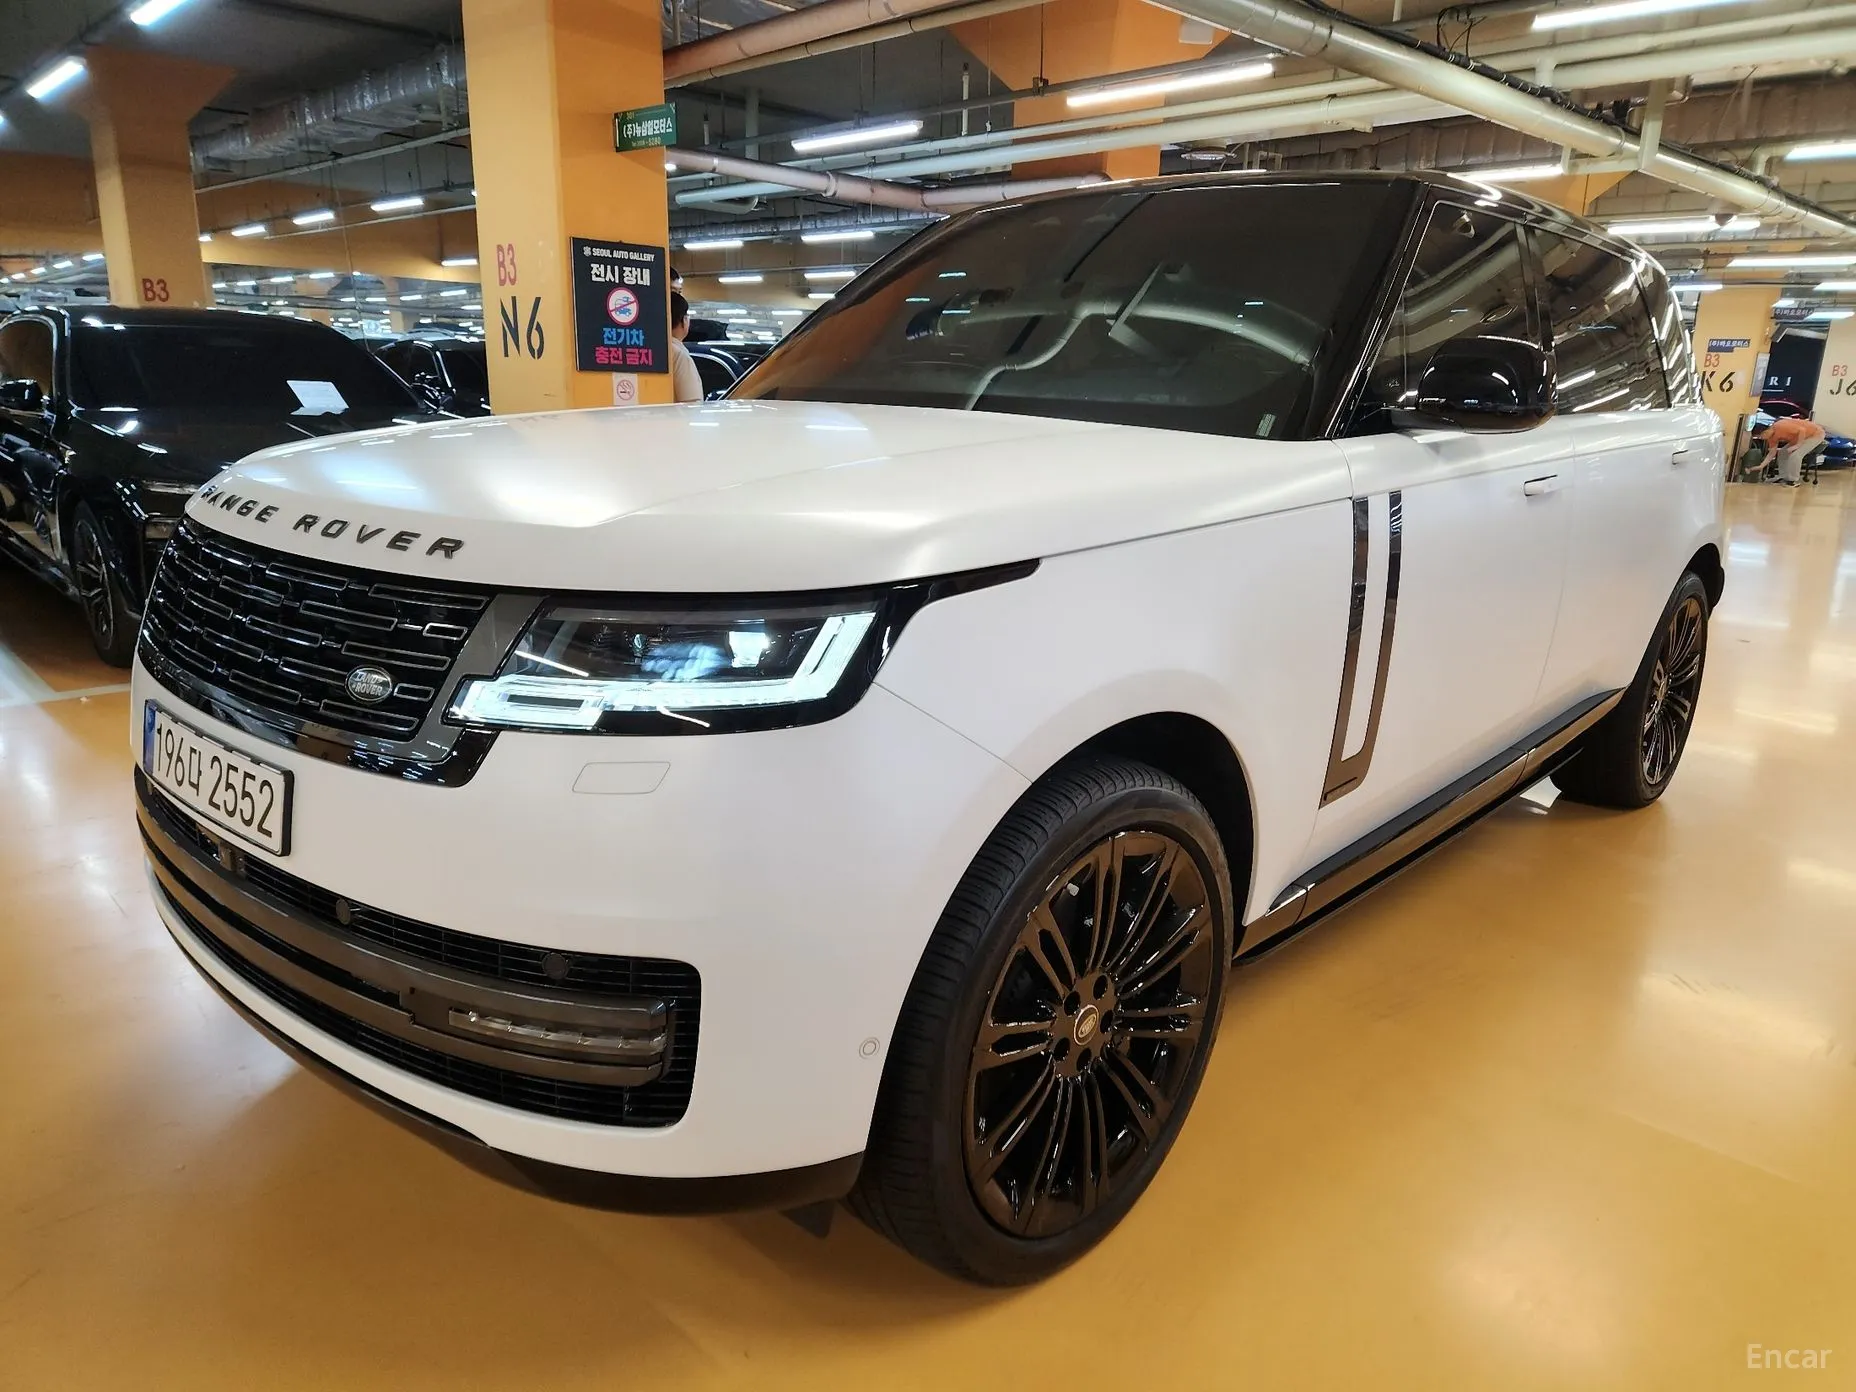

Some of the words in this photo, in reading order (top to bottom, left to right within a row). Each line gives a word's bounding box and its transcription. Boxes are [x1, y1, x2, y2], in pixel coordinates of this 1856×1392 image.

[496, 243, 517, 287] B3
[592, 247, 612, 258] SEOUL
[612, 249, 629, 260] AUTO
[629, 251, 655, 262] GALLERY
[590, 263, 619, 283] 전시
[622, 266, 651, 286] 장내
[142, 278, 169, 302] B3
[500, 296, 545, 360] N6
[602, 327, 645, 346] 전기차
[595, 346, 623, 364] 충전
[625, 348, 653, 366] 금지
[1704, 353, 1720, 368] B3
[1831, 365, 1848, 376] B3
[1701, 371, 1735, 392] K6
[201, 485, 280, 524] RANGE
[292, 513, 465, 560] ROVER
[354, 682, 383, 697] ROVER
[156, 722, 203, 797] 196다
[207, 755, 274, 839] 2552
